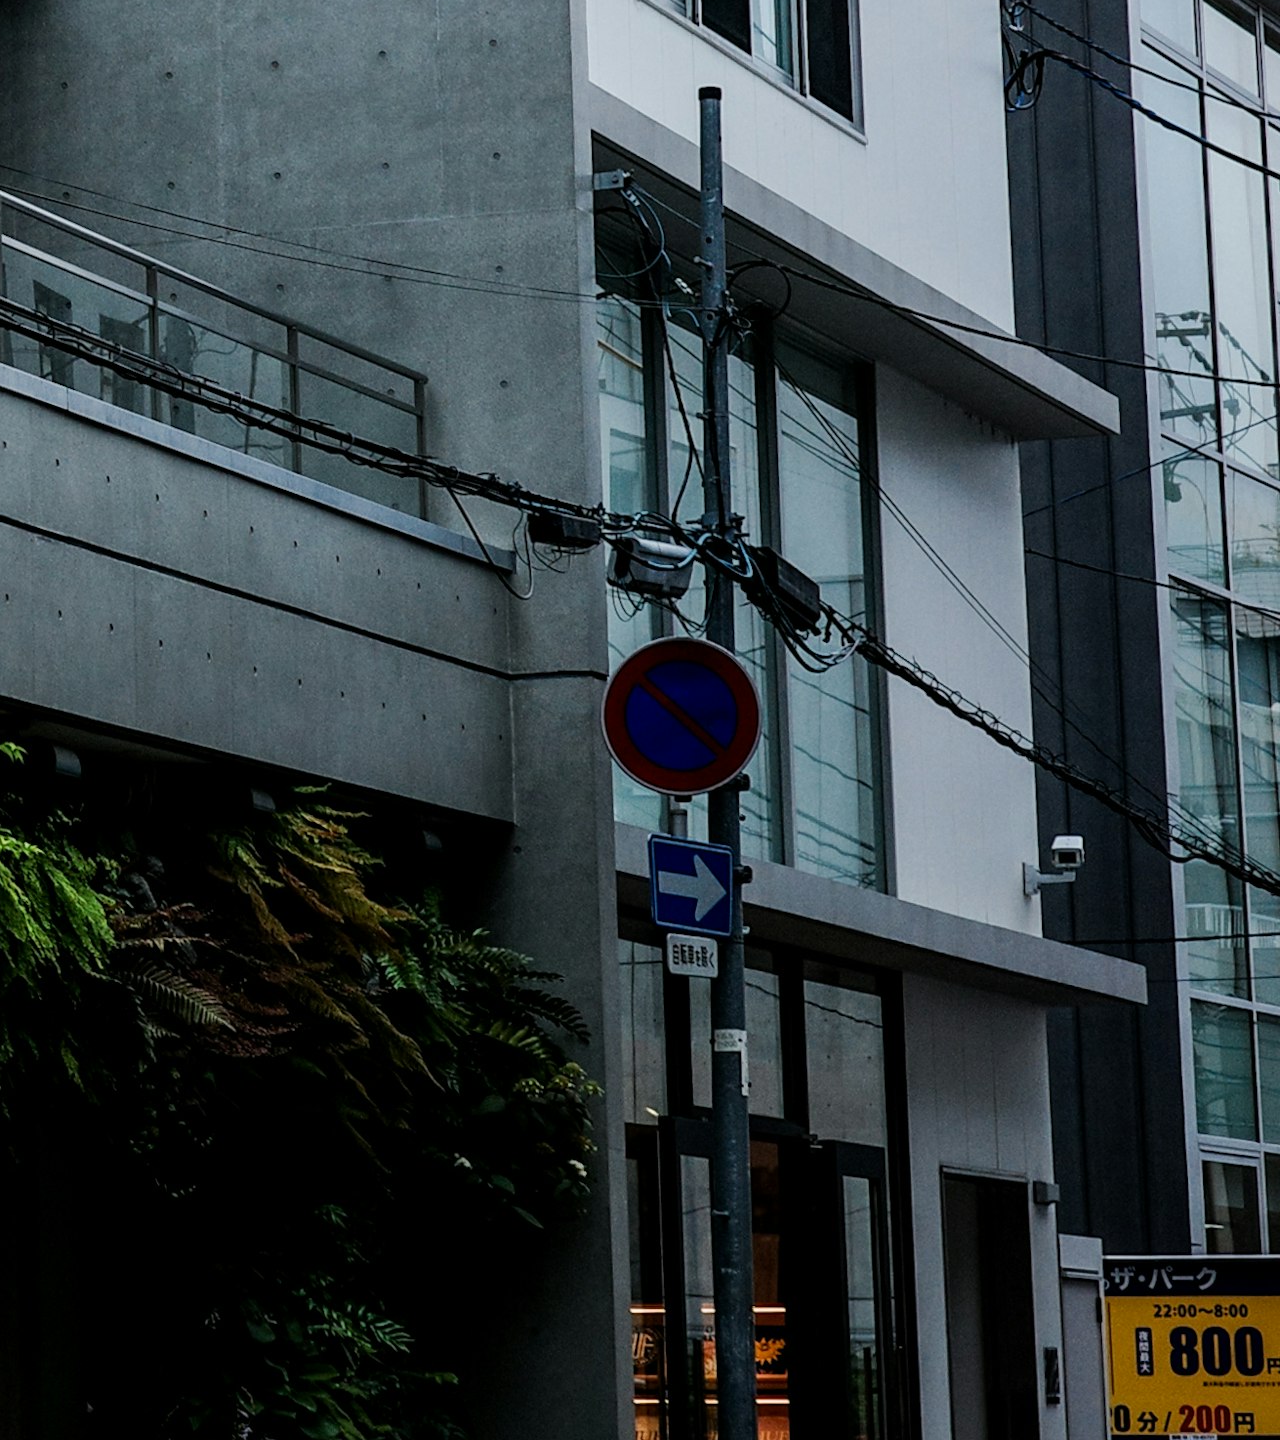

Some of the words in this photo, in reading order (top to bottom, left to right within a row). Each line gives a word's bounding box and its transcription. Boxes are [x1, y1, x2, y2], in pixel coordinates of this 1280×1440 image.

[673, 944, 715, 969] 自転車を除く
